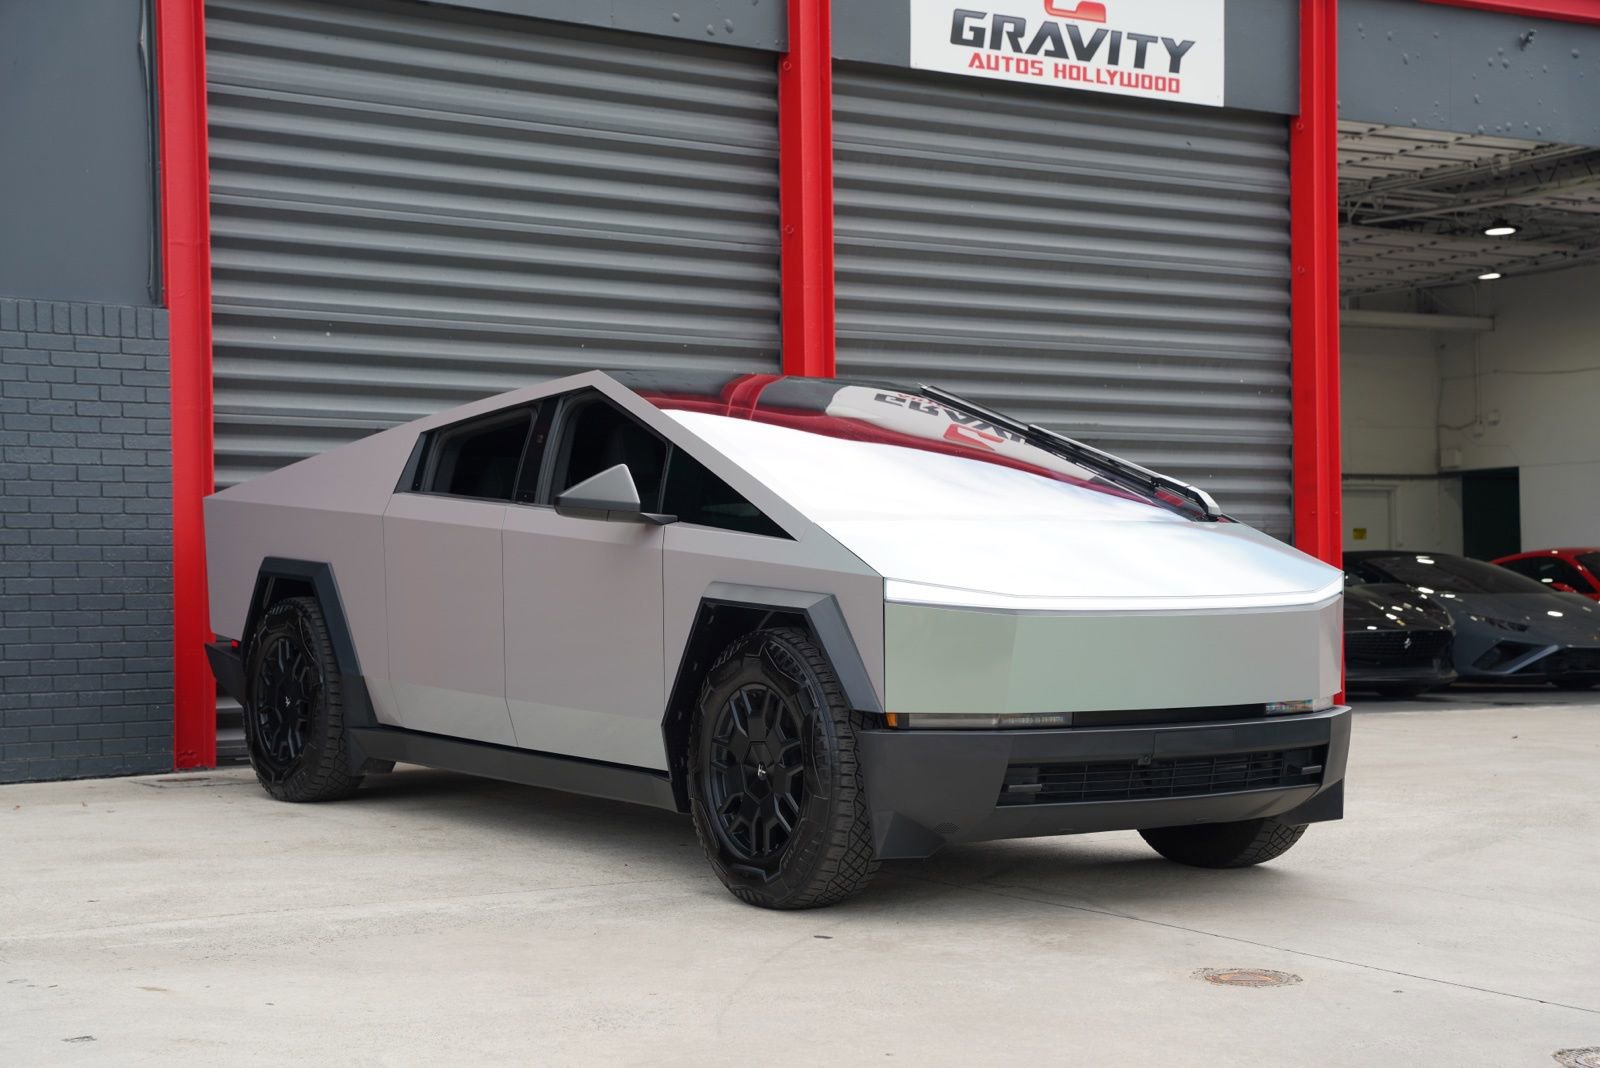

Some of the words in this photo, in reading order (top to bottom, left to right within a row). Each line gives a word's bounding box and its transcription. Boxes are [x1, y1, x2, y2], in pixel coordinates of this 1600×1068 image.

[950, 8, 1196, 74] GRAVITY
[968, 52, 1044, 77] AUTOS
[1053, 63, 1180, 94] HOLLYWOOD
